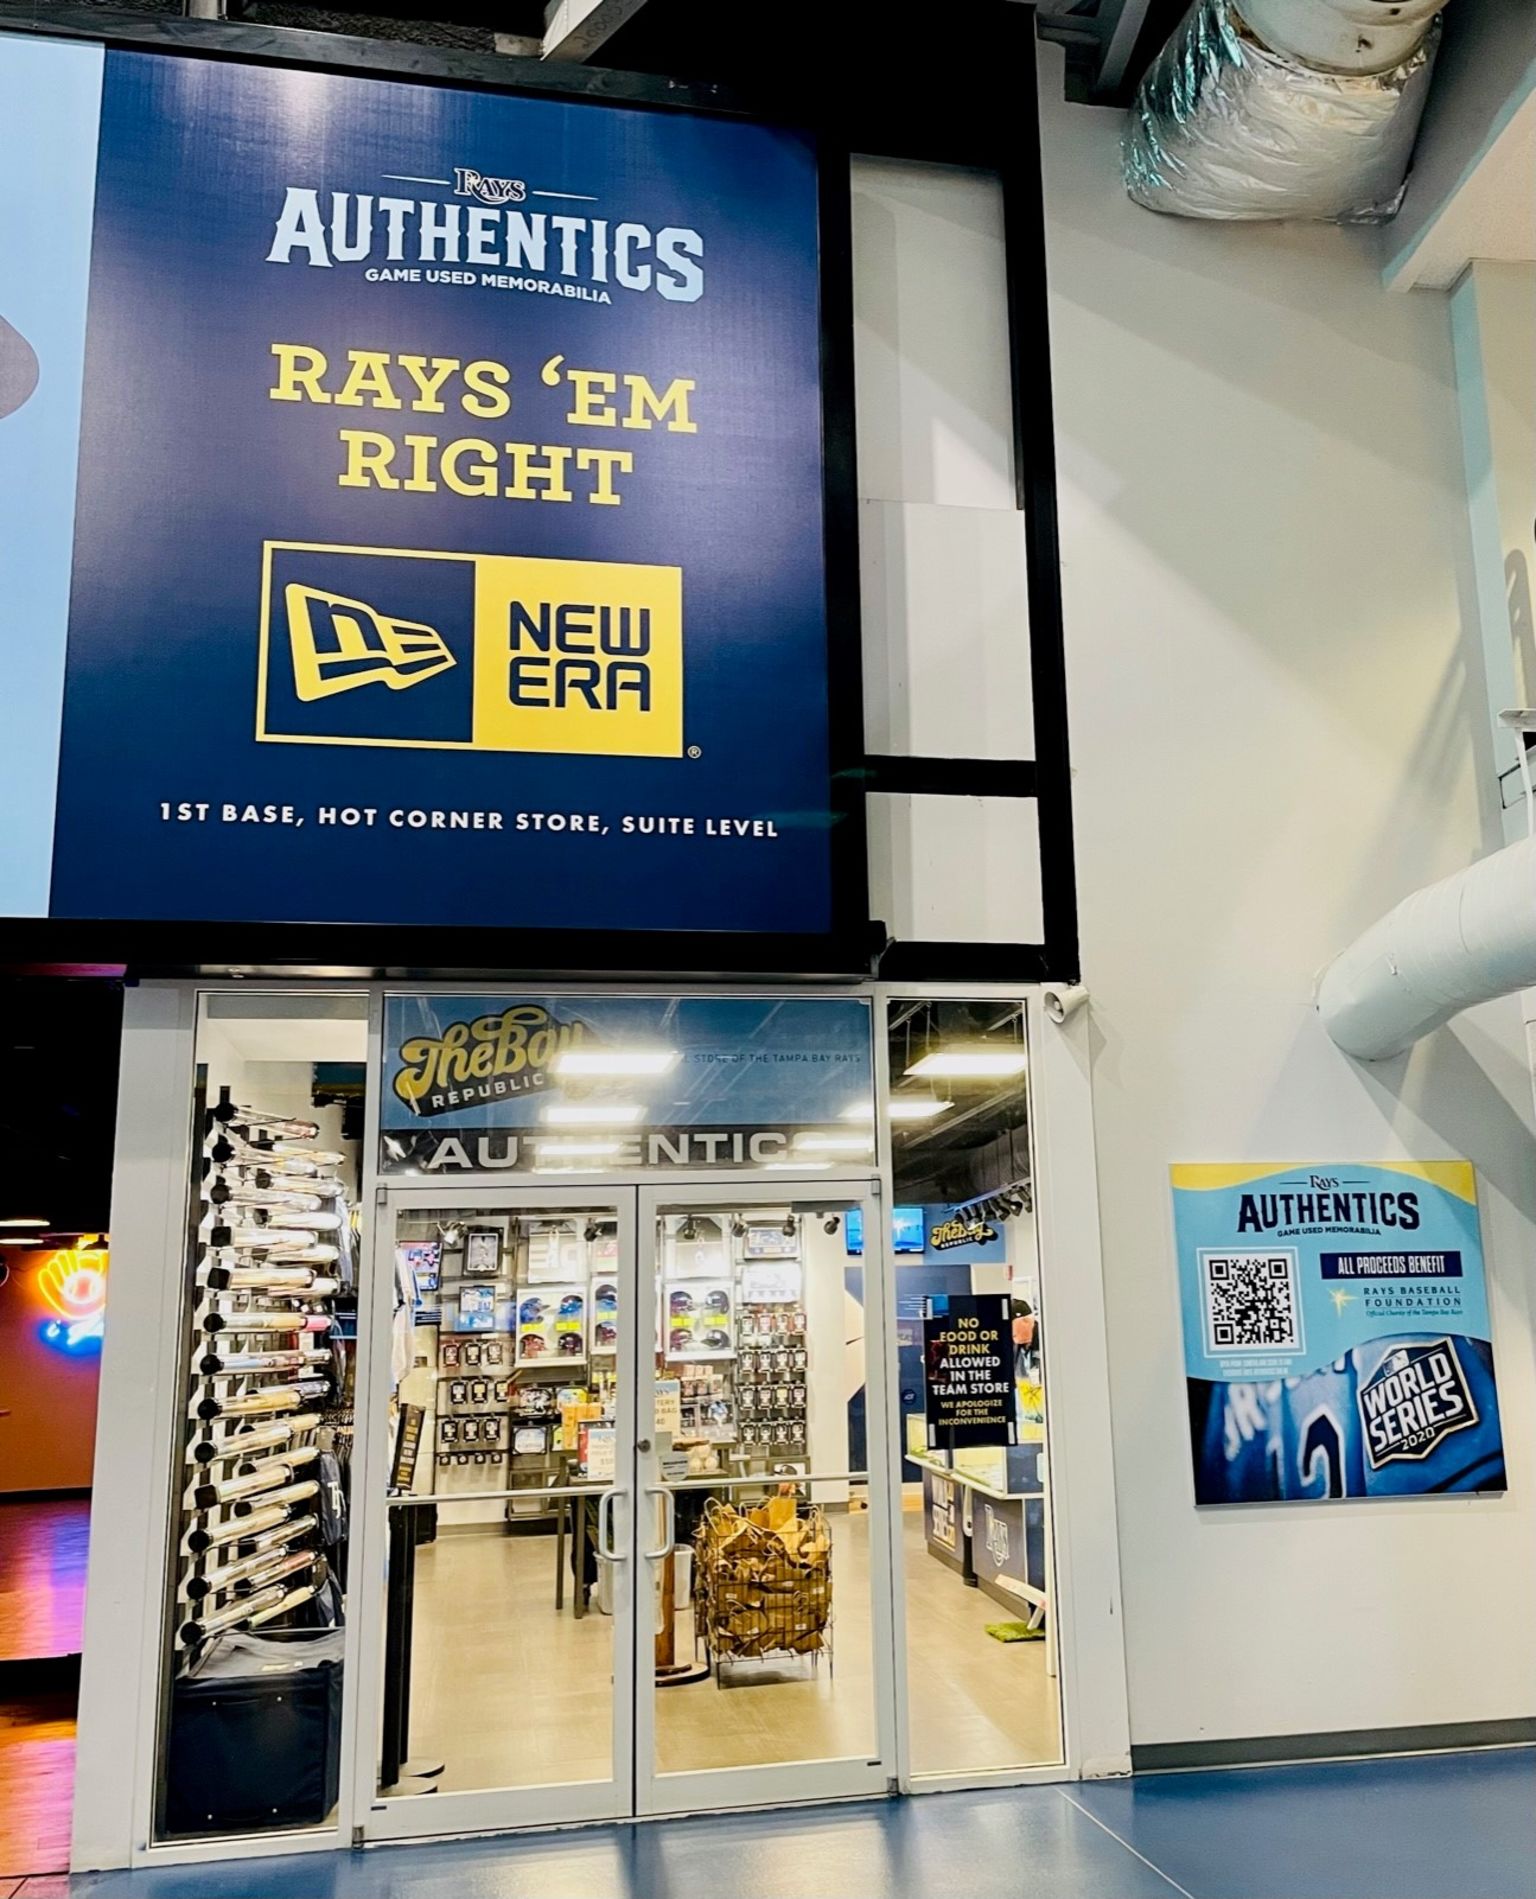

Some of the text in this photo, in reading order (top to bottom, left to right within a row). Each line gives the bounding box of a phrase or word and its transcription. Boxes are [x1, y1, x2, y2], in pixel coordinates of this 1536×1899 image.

[453, 167, 527, 205] RAYS
[265, 187, 704, 303] AUTHENTICS
[365, 268, 612, 305] GAME USED MEMORABILIA
[270, 343, 511, 419] RAYS
[338, 430, 633, 505] RIGHT
[510, 600, 650, 657] NEW
[509, 656, 650, 712] ERA
[160, 802, 778, 837] 1ST BASE, HOT CORNER STORE, SUITE LEVEL
[750, 1054, 768, 1063] THE
[773, 1053, 808, 1062] TAMPA
[812, 1053, 830, 1063] BAY
[432, 1073, 544, 1108] REPUBLIC
[427, 1131, 831, 1168] AUTENTIC
[1309, 1175, 1339, 1190] RAYS
[1237, 1192, 1420, 1232] AUTHENTICS
[1277, 1226, 1381, 1237] GAME USED MEMORABILIA
[1338, 1255, 1445, 1274] ALL PROCEEDS BENEFIT
[1364, 1286, 1460, 1295] RAYS BASEBALL
[1365, 1297, 1461, 1307] FOUNDATION
[958, 1317, 979, 1329] NO
[940, 1330, 999, 1342] FOOD OR
[949, 1344, 990, 1355] DRINK
[940, 1356, 1001, 1369] ALLOWED
[950, 1370, 991, 1382] IN THE
[932, 1382, 1010, 1396] TEAM STORE
[1364, 1353, 1452, 1419] WORLD
[940, 1399, 1002, 1409] WE APOLOGIZE
[974, 1408, 988, 1416] THE
[938, 1416, 1006, 1425] INCONVENIENCE
[1370, 1380, 1464, 1452] SERIES
[1401, 1427, 1435, 1451] 2020
